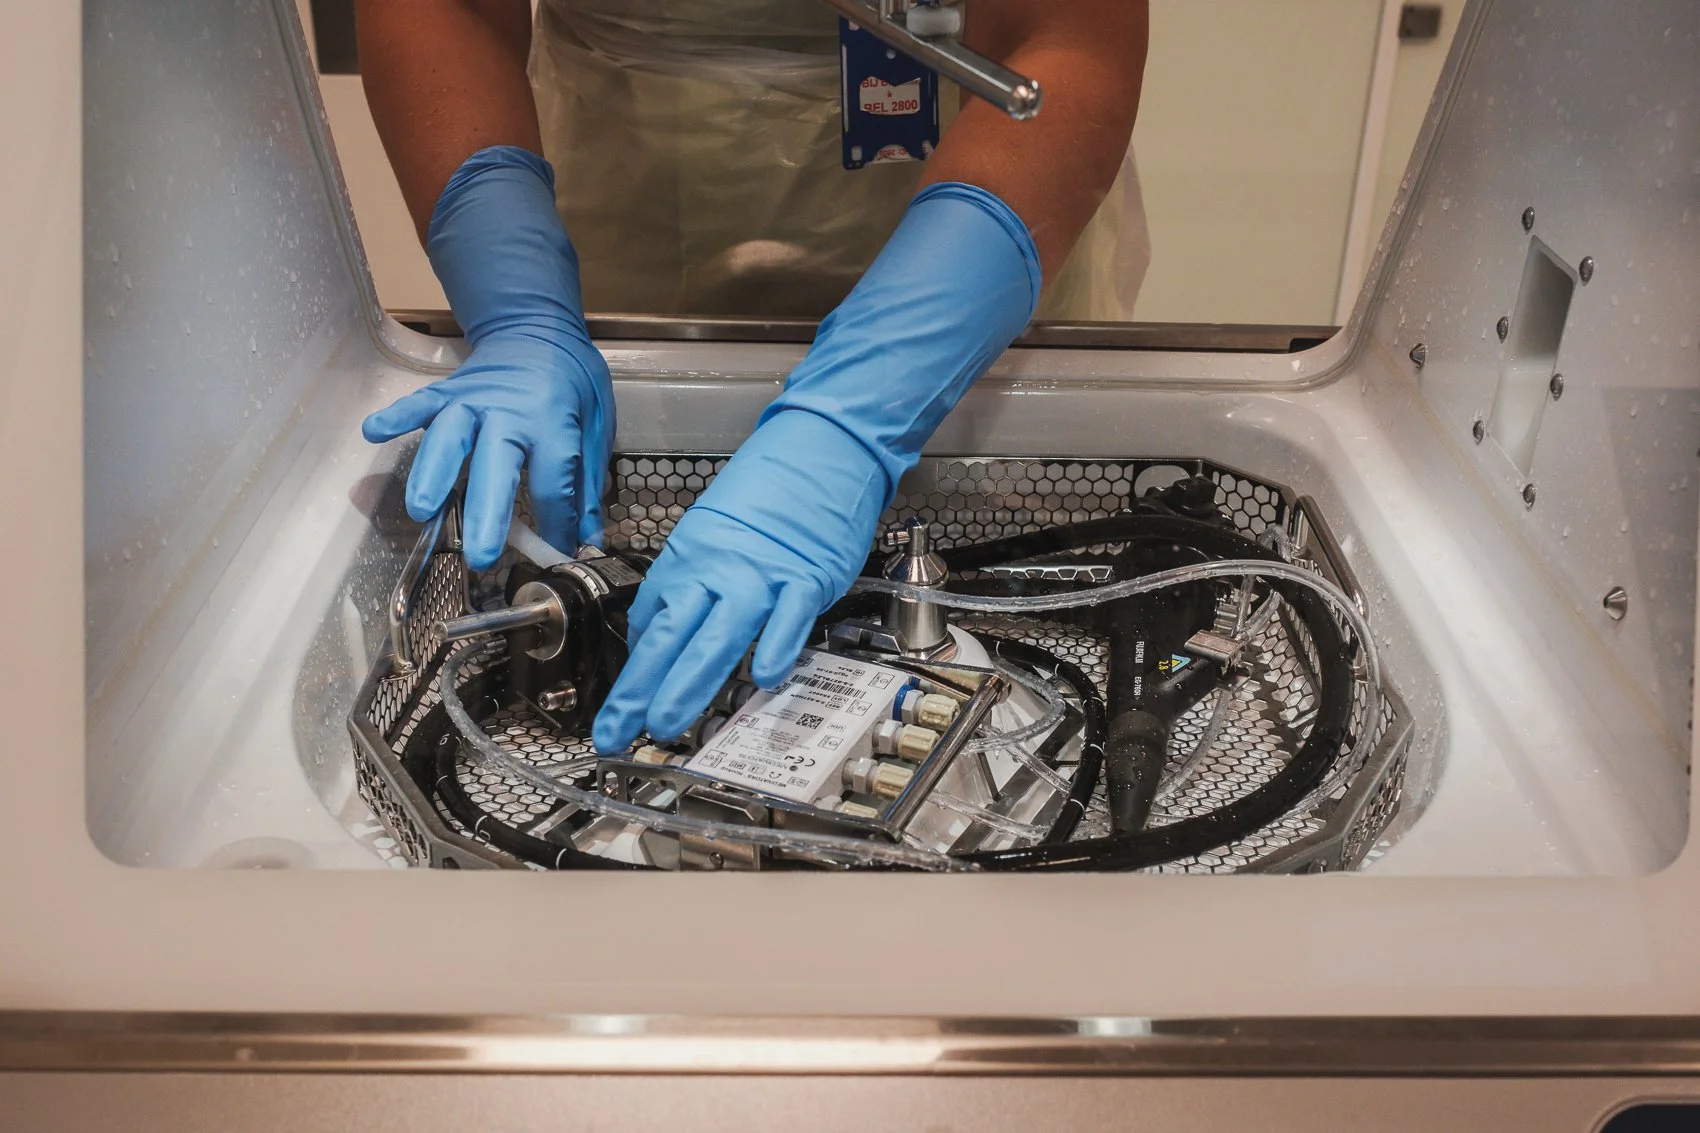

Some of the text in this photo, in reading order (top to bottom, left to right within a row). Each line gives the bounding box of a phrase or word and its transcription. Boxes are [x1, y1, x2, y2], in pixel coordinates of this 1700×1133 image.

[891, 100, 918, 112] 2800
[1135, 641, 1144, 664] FUJIFILM
[1158, 660, 1169, 671] 2.8
